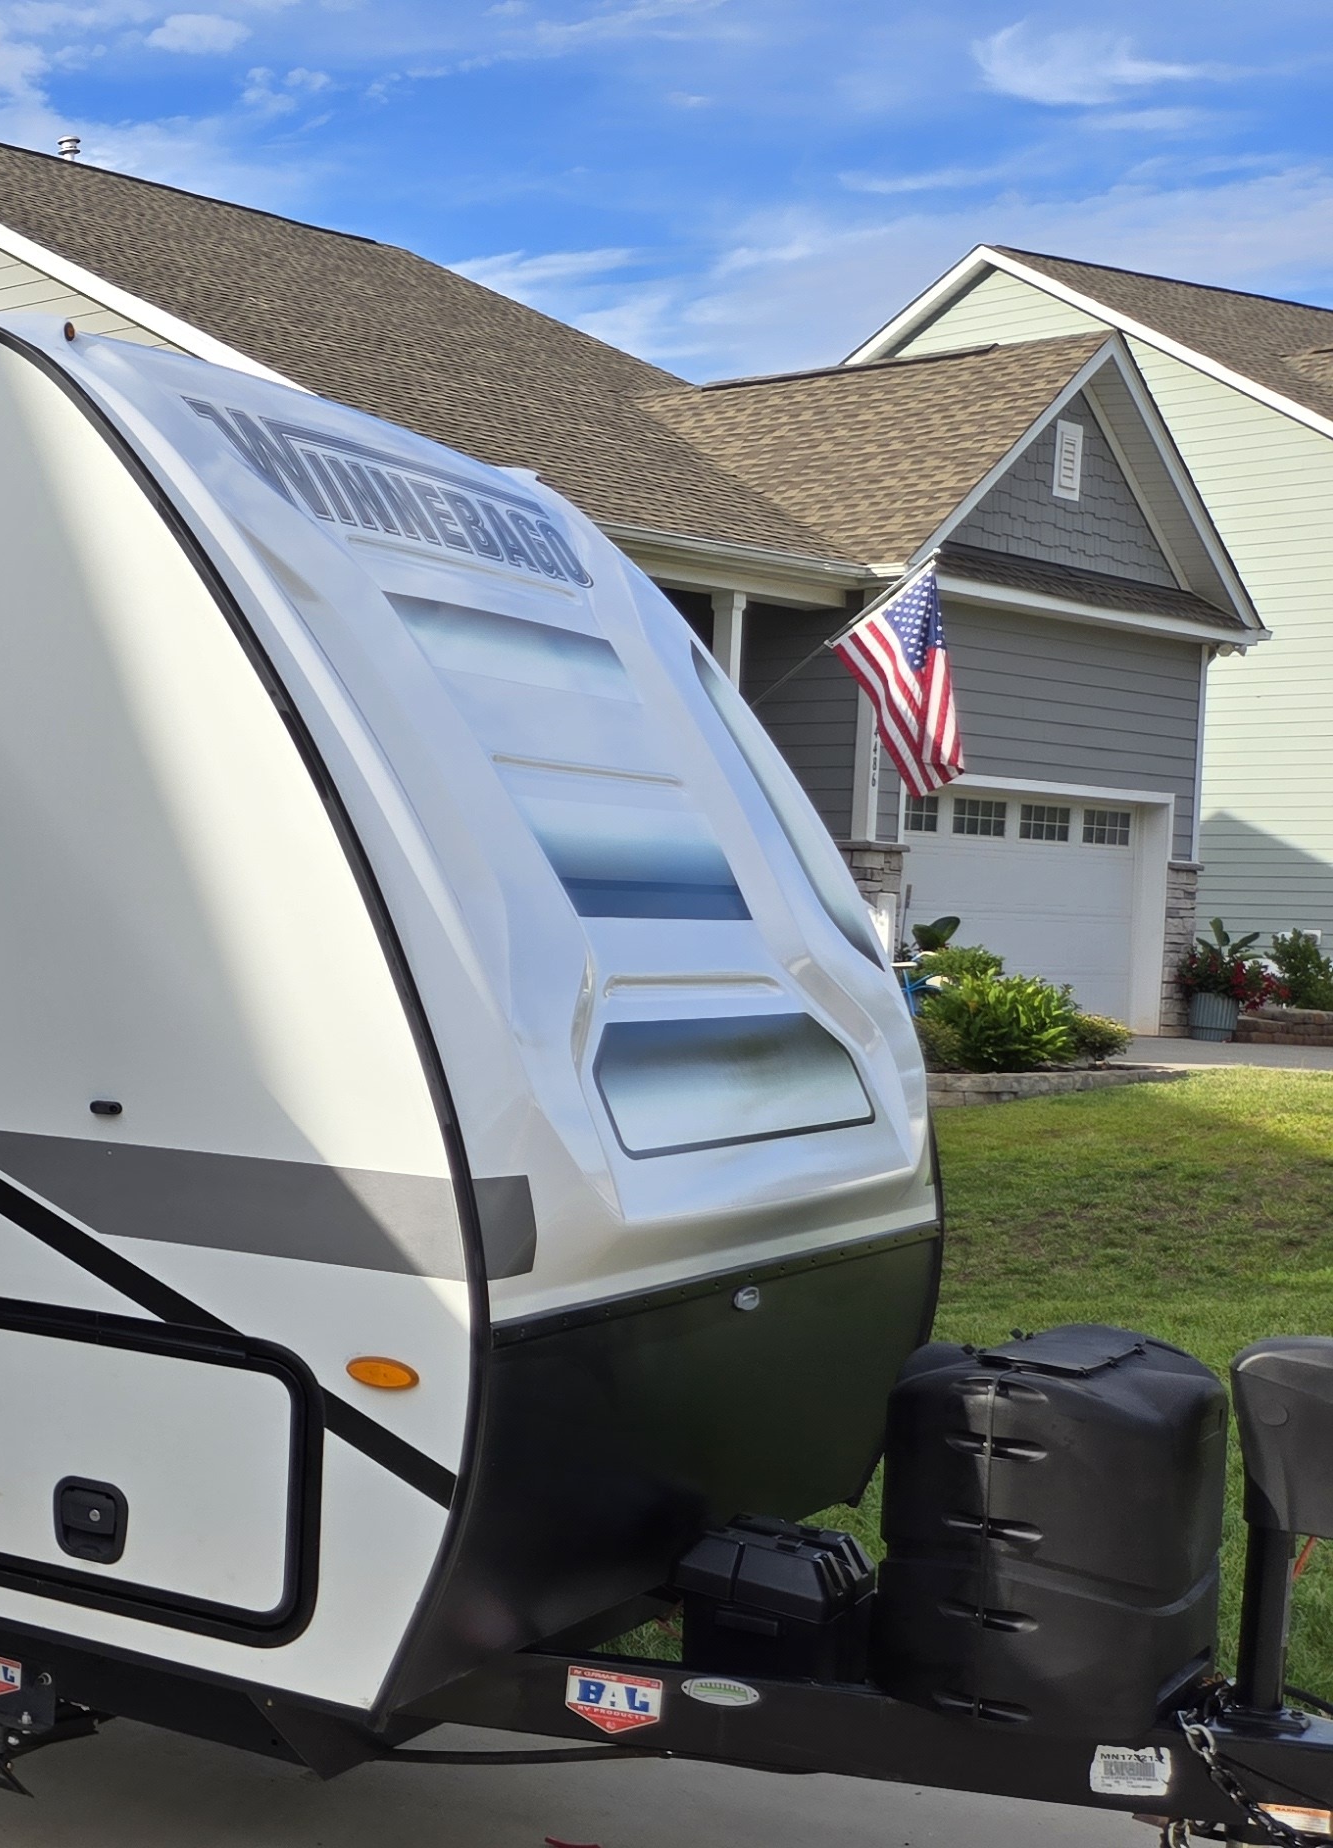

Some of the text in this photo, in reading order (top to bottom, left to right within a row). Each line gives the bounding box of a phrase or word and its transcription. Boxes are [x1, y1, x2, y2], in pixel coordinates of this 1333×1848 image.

[181, 395, 593, 588] WINNEBAGO
[577, 1679, 650, 1713] BAL
[577, 1704, 590, 1712] RV
[593, 1706, 646, 1721] PRODUCTS
